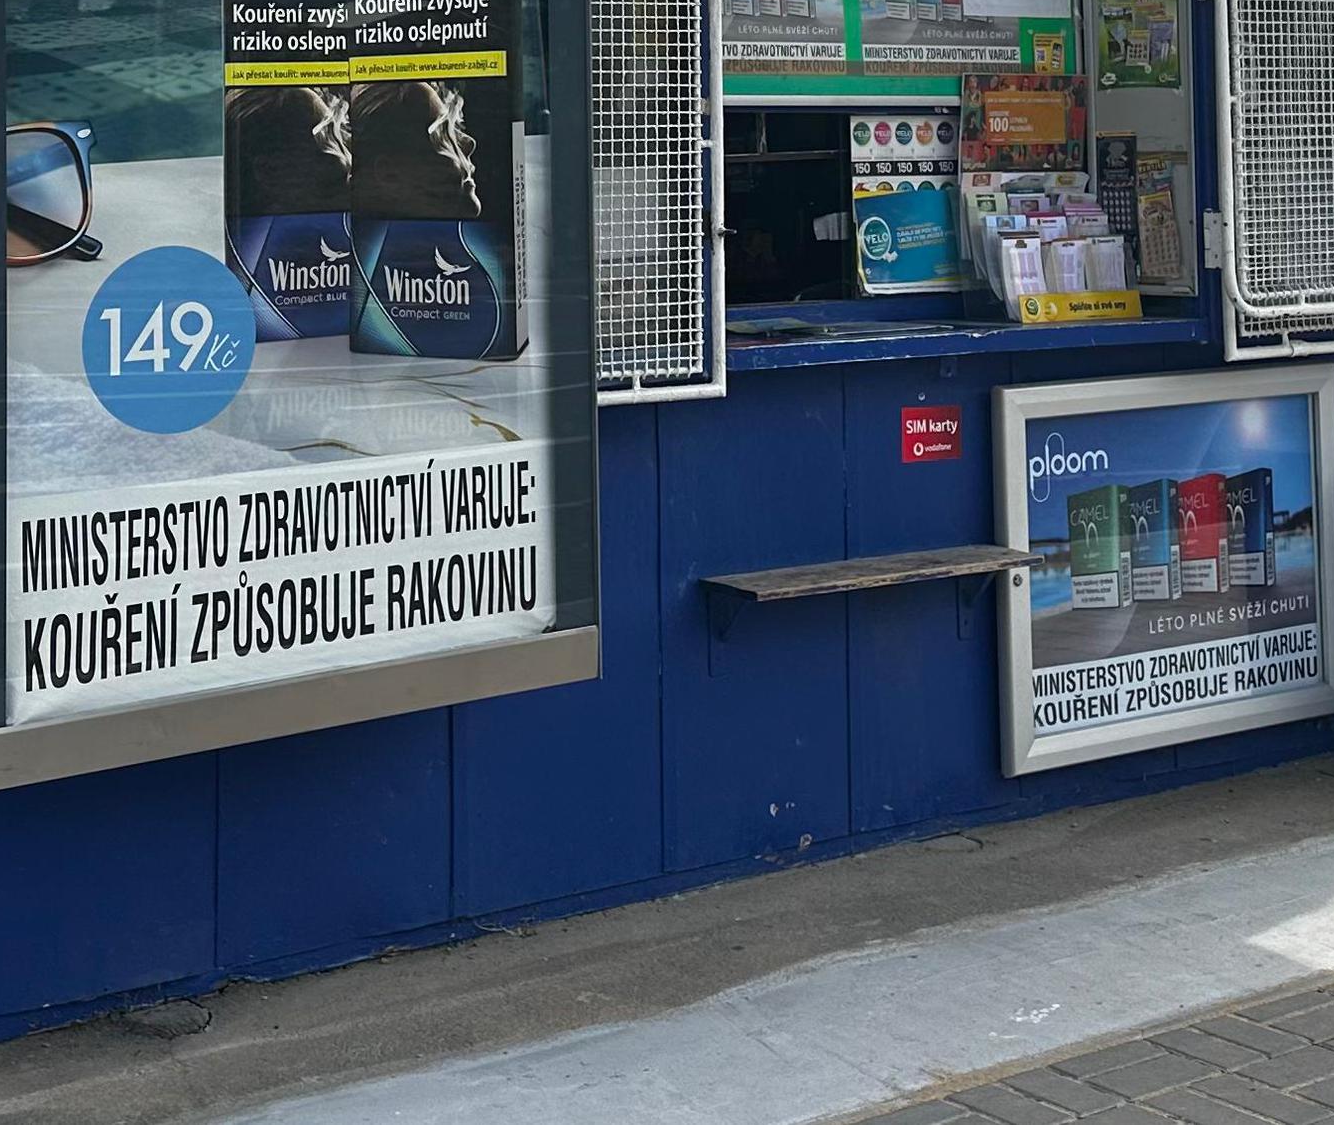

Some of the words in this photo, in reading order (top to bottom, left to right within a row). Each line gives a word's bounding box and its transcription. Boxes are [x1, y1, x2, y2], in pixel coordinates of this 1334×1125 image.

[232, 3, 302, 24] Kouření
[232, 32, 283, 52] riziko
[287, 30, 347, 55] oslepn
[355, 22, 404, 44] riziko
[408, 16, 488, 45] oslepnutí
[741, 43, 809, 58] ZDRAVOTNICTVÍ
[864, 47, 924, 60] MINISTERSTVO
[926, 47, 986, 61] ZDRAVOTNICTVÍ
[989, 117, 1009, 132] 100
[855, 163, 871, 174] 150
[876, 163, 892, 173] 150
[897, 162, 913, 173] 150
[918, 161, 933, 172] 150
[938, 161, 954, 172] 150
[864, 232, 889, 244] VELO
[268, 255, 350, 291] Winston
[384, 265, 470, 306] Winston
[275, 293, 323, 306] Compact
[326, 292, 347, 302] BLUE
[390, 306, 441, 320] Compact
[443, 312, 471, 321] GREEN
[99, 302, 213, 376] 149
[203, 340, 242, 373] Kč
[906, 419, 926, 434] SIM
[929, 419, 958, 434] karty
[925, 443, 952, 452] vodafone
[1029, 432, 1109, 503] ploom
[21, 495, 228, 593] MINISTERSTVO
[238, 459, 436, 563] ZDRAVOTNICTVÍ
[441, 460, 537, 534] VARUJE:
[24, 583, 179, 692] KOUŘENÍ
[190, 570, 375, 663] ZPŮSOBUJE
[387, 545, 537, 632] RAKOVINU
[1149, 615, 1184, 634] LÉTO
[1190, 606, 1224, 627] PLNÉ
[1228, 601, 1267, 623] SVĚŽÍ
[1270, 595, 1310, 614] CHUTI
[1033, 658, 1145, 698] MINISTERSTVO
[1149, 635, 1260, 679] ZDRAVOTNICTVÍ
[1263, 629, 1317, 657] VARUJE:
[1033, 688, 1120, 728] KOUŘENÍ
[1126, 671, 1228, 713] ZPŮSOBUJE
[1235, 656, 1317, 693] RAKOVINU
